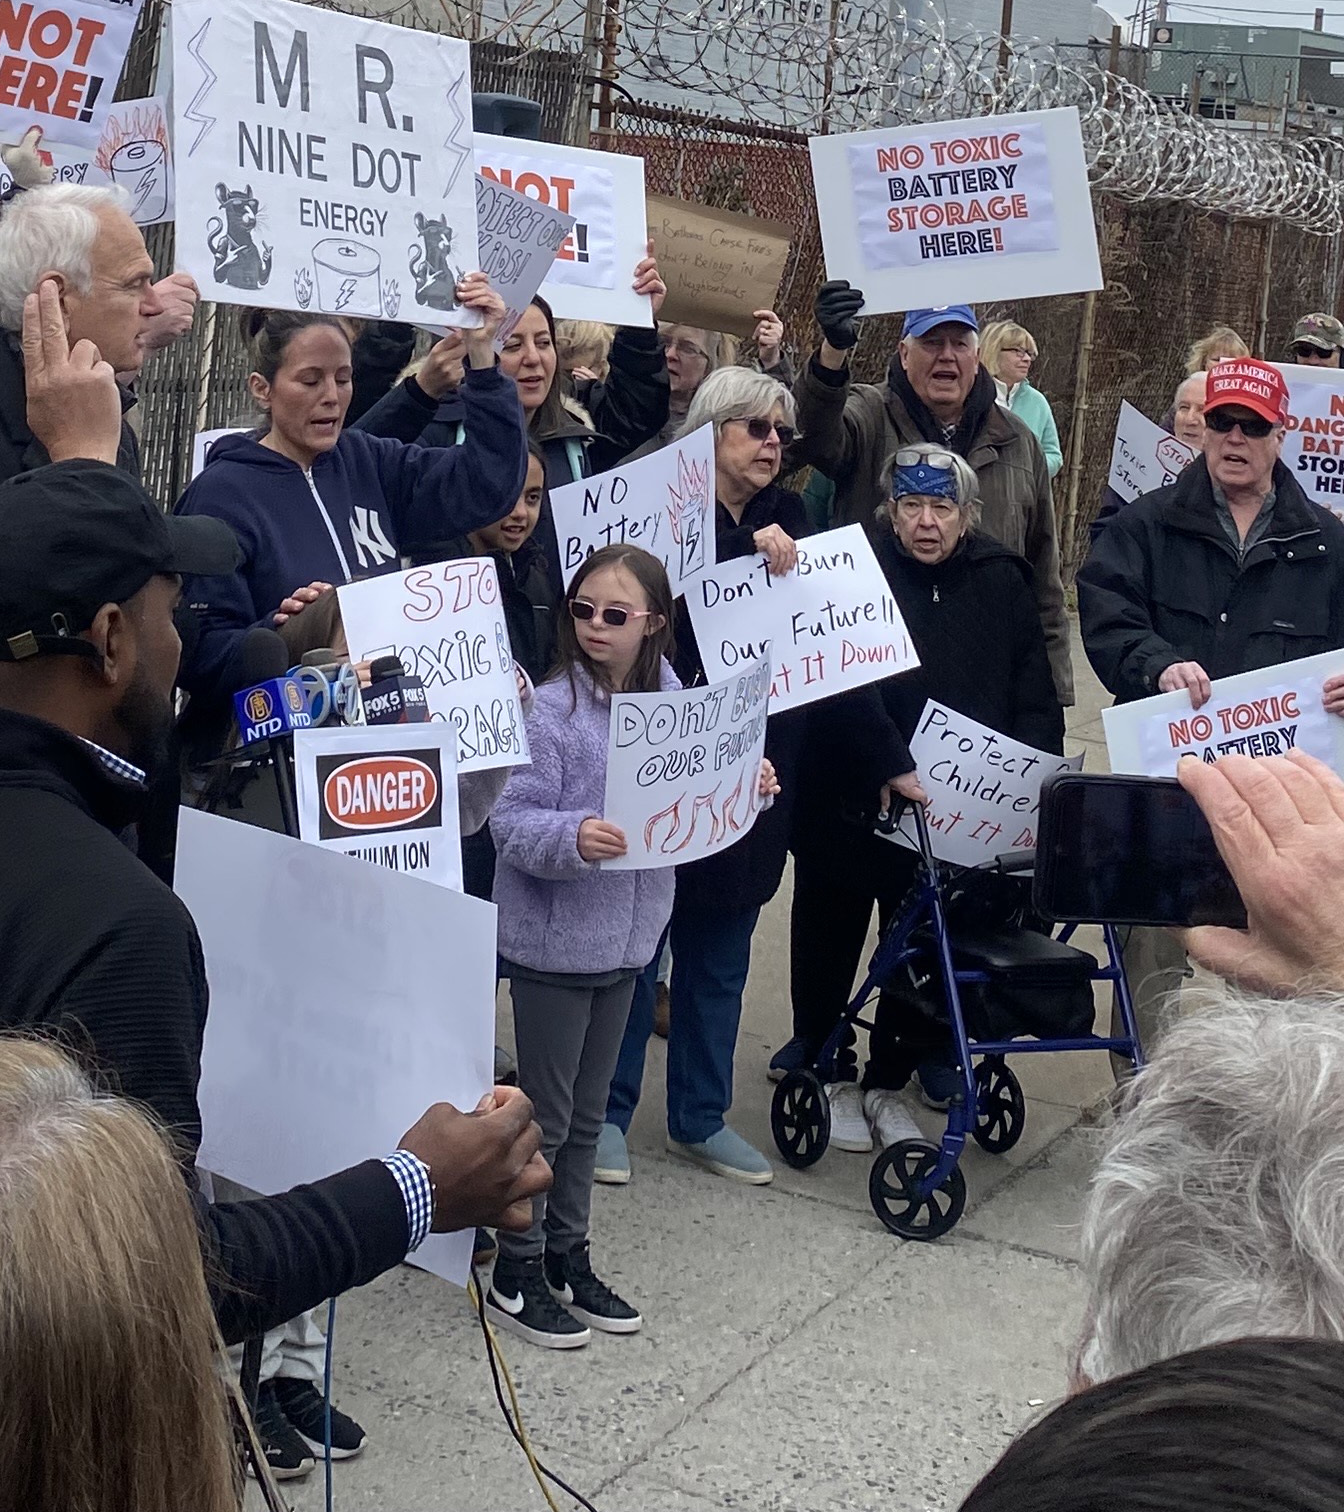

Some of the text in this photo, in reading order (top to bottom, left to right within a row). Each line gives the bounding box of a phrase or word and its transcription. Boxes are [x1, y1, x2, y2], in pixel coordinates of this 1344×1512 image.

[238, 121, 422, 197] NINE DOT
[877, 133, 1023, 173] NO TOXIC
[887, 164, 1018, 202] BATTERY
[300, 197, 388, 237] ENERGY
[887, 194, 1029, 233] STORAGE
[919, 227, 1004, 259] HERE!
[1212, 364, 1279, 388] MAKE AMERICA
[1214, 379, 1272, 400] GREAT AGAIN
[583, 476, 628, 517] NO
[703, 558, 772, 608] Don't
[796, 550, 855, 576] Burn
[800, 650, 825, 686] It
[841, 635, 909, 673] Down!
[247, 717, 282, 741] NTD
[289, 713, 311, 727] NTD
[1168, 692, 1301, 748] NO TOXIC
[921, 708, 1040, 778] Protect
[637, 744, 706, 787] OUR
[336, 770, 426, 816] DANGER
[968, 820, 1003, 845] It
[404, 841, 430, 871] ION
